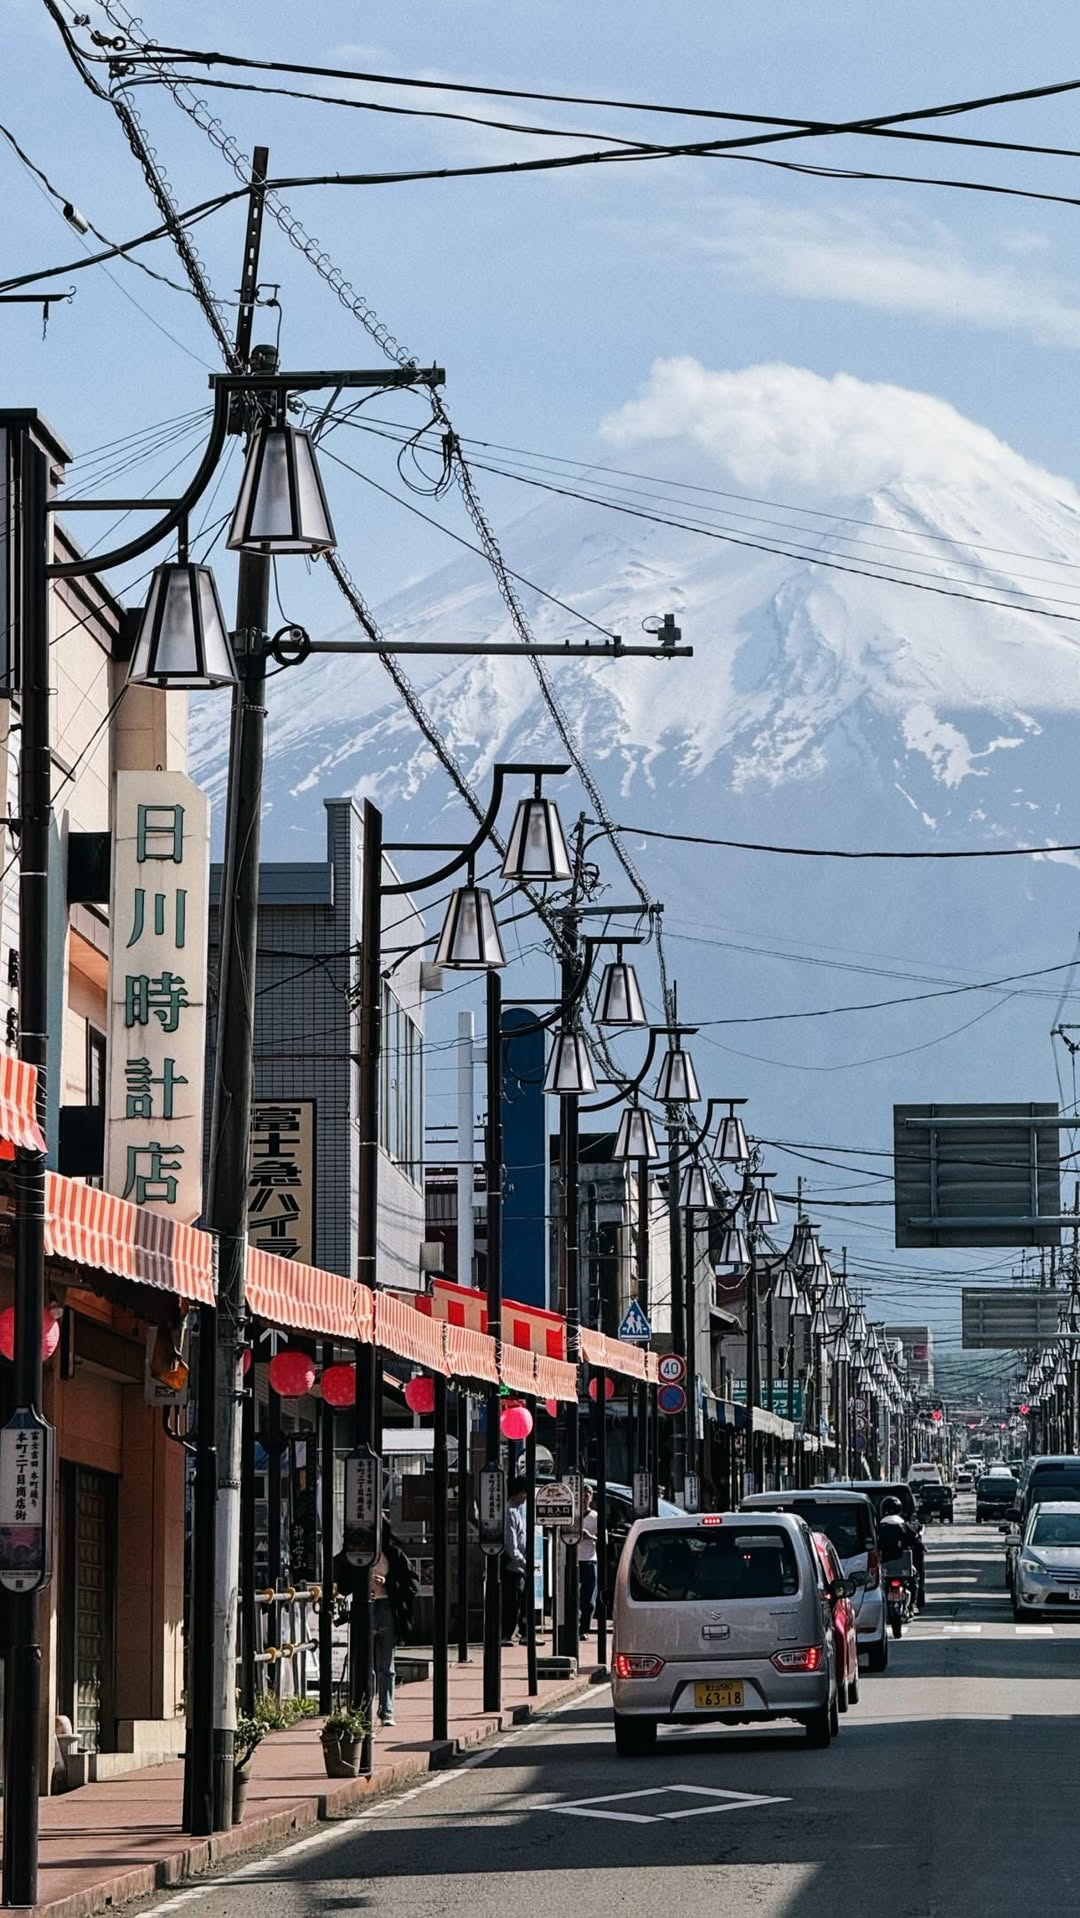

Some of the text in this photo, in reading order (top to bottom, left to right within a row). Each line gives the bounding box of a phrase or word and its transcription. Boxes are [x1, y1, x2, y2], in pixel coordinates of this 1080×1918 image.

[120, 803, 190, 1205] 日川時計店
[663, 1362, 679, 1375] 40
[30, 1431, 40, 1467] 富士吉田
[15, 1431, 29, 1521] 本町二丁目商店街
[705, 1691, 742, 1706] 63-18
